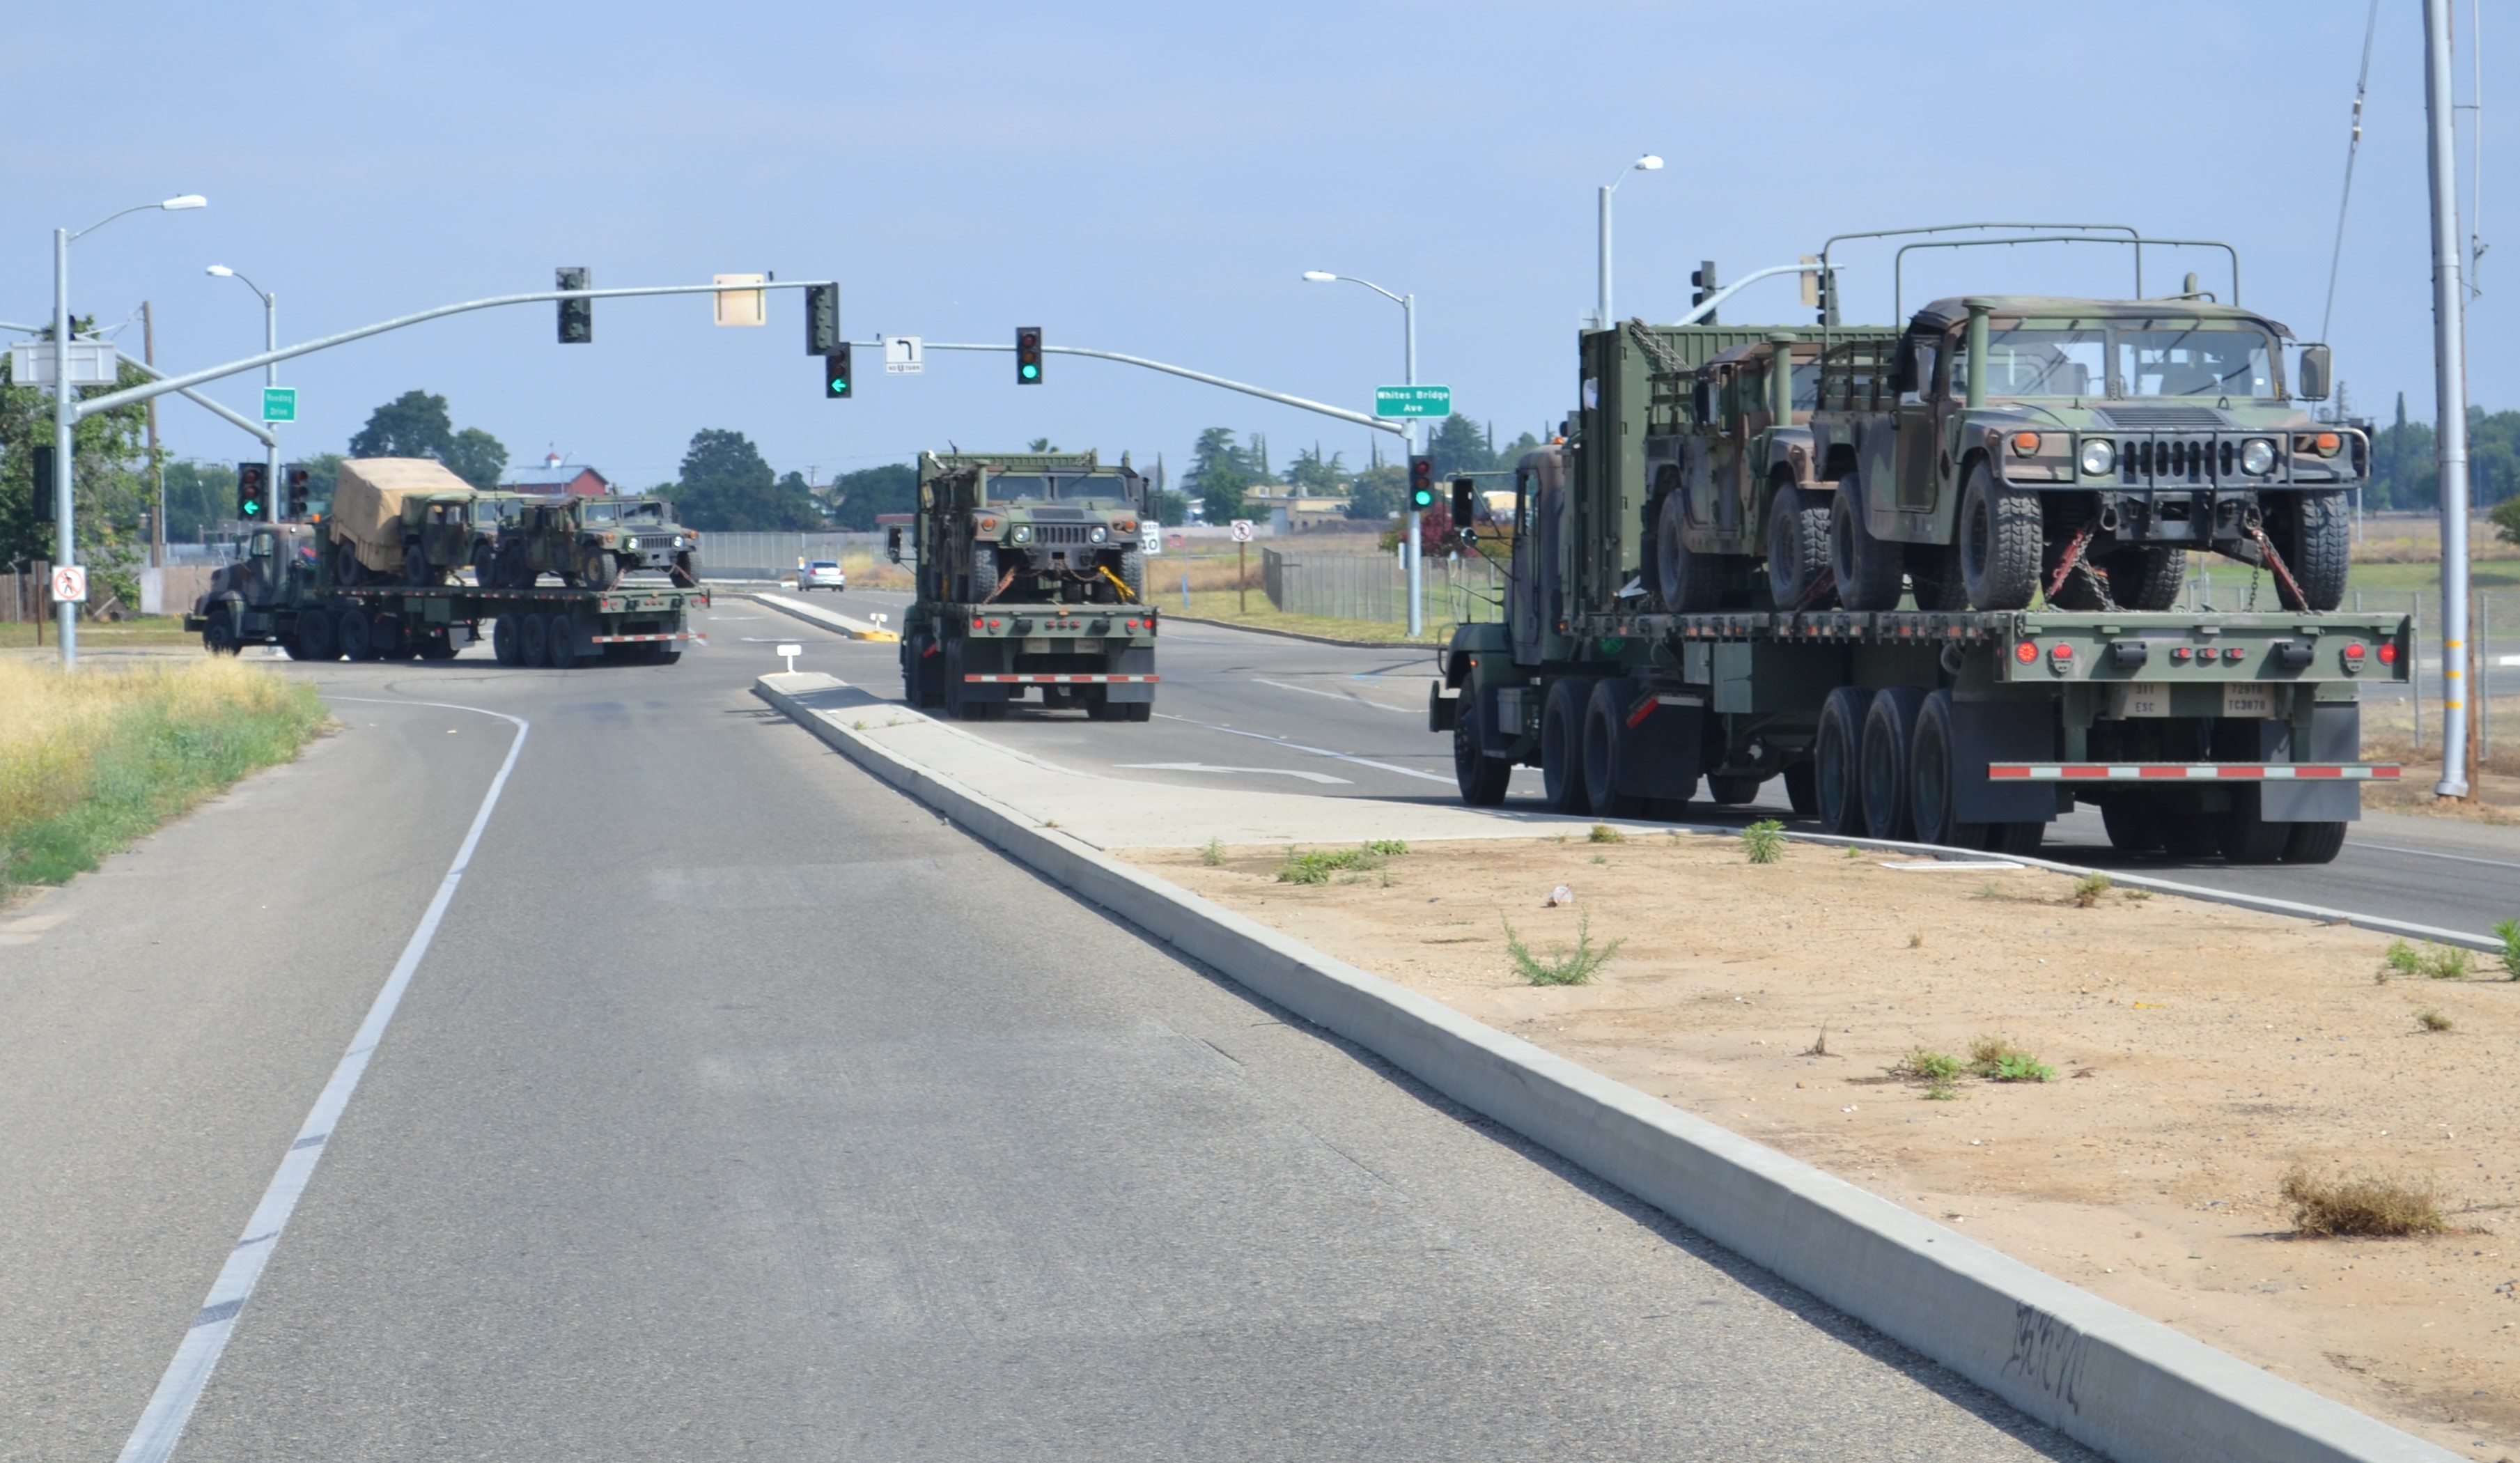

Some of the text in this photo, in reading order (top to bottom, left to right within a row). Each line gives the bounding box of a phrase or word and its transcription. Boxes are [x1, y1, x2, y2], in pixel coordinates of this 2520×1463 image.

[1377, 391, 1449, 401] Whites Bridge
[1403, 404, 1423, 412] Ave
[2136, 702, 2155, 712] ESC
